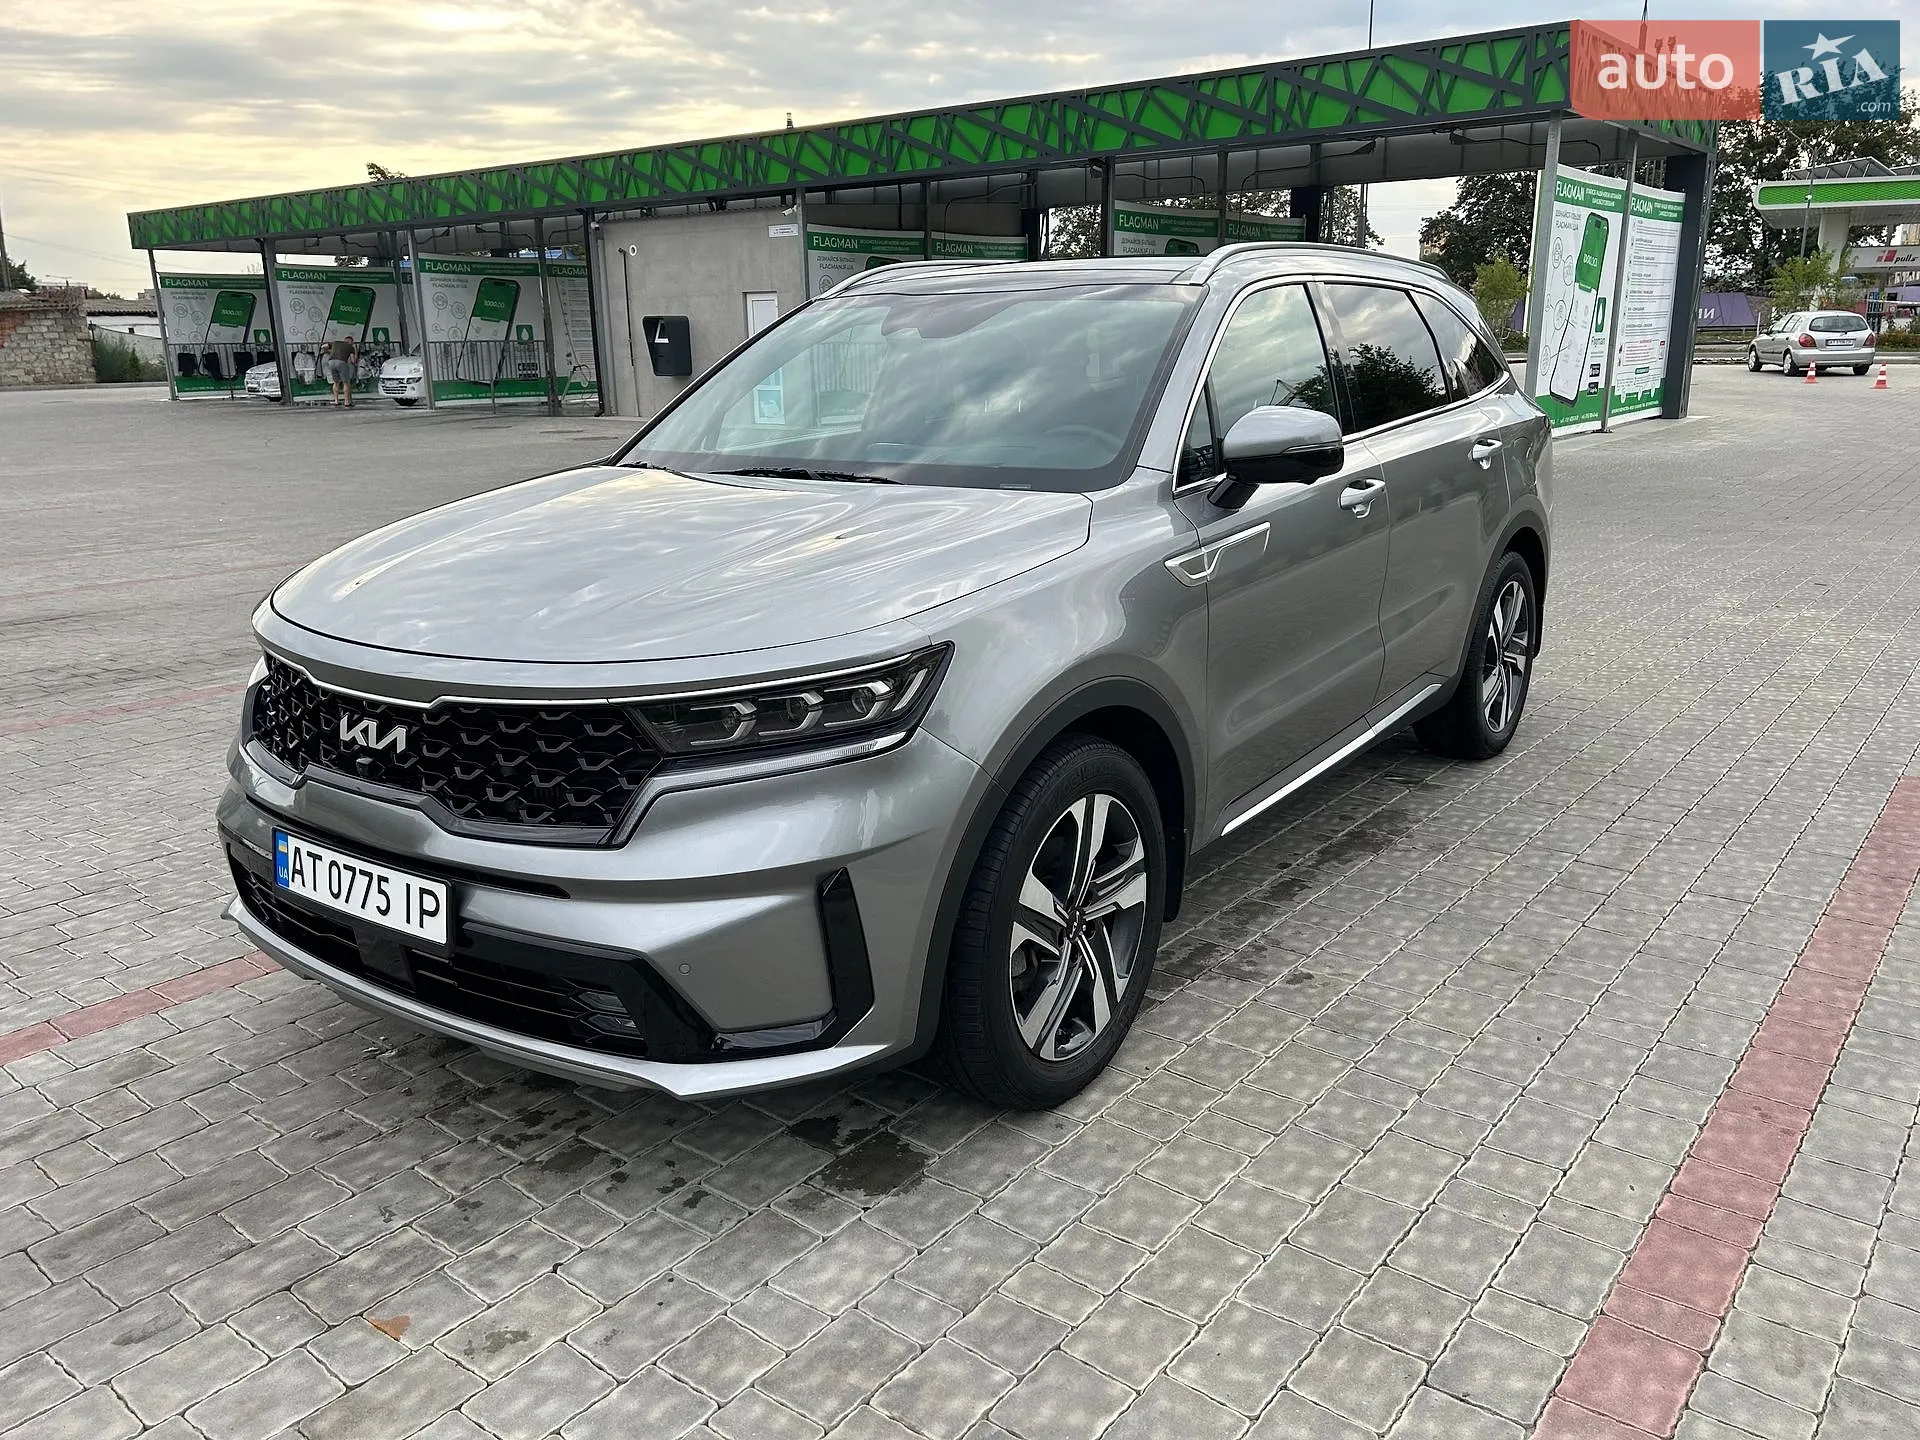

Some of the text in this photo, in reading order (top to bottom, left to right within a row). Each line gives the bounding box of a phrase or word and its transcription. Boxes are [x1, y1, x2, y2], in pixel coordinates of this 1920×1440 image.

[1555, 180, 1586, 201] FLAGMAN
[1630, 197, 1654, 215] FLAGMAN
[1119, 214, 1160, 230] FLAGMAN
[1228, 223, 1261, 237] FLAGMAN
[813, 236, 859, 249] FLAGMAN
[936, 241, 974, 254] FLAGMAN
[425, 261, 472, 273] FLAGMAN
[551, 266, 588, 276] FLAGMA
[281, 270, 326, 281] FLAGMAN
[165, 278, 209, 288] FLAGMAN
[339, 714, 407, 754] KIA
[278, 866, 289, 880] UA
[291, 846, 440, 929] AT 0775 IP
